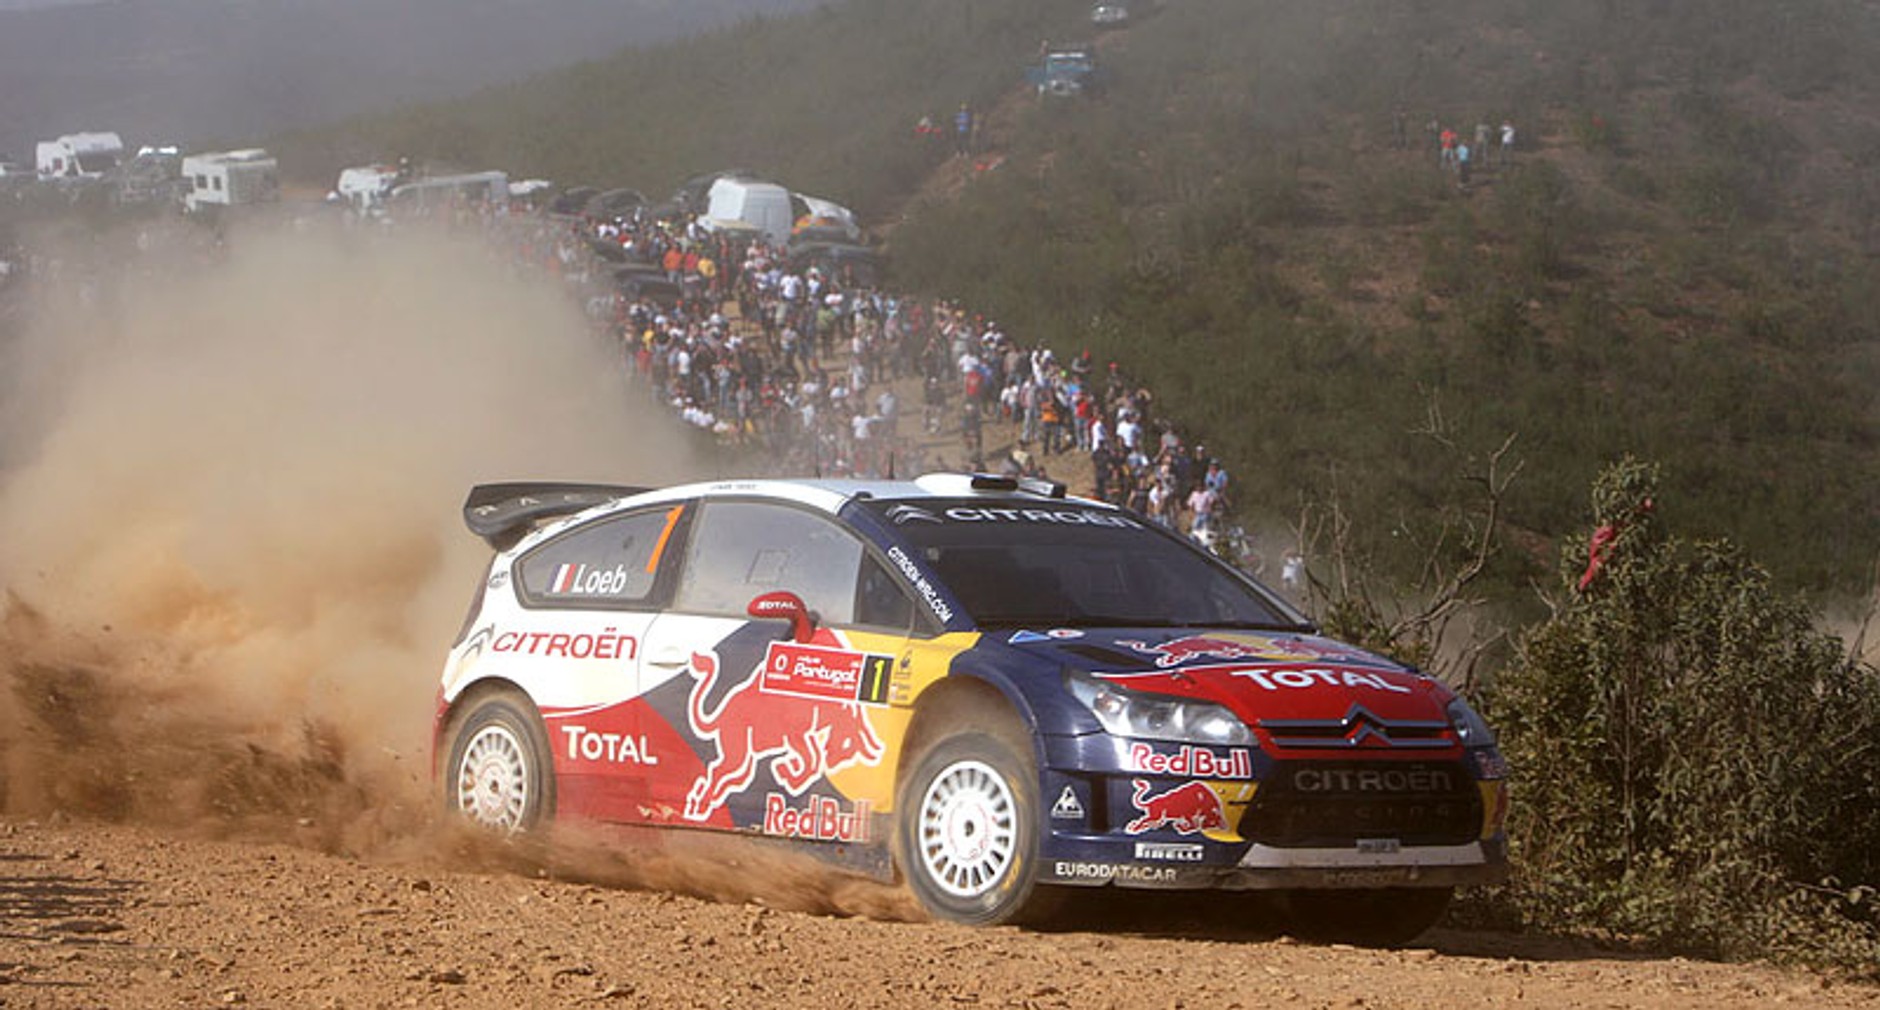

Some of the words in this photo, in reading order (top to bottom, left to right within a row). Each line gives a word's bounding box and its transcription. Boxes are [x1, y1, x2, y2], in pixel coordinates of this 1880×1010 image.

[645, 503, 685, 574] 1
[571, 563, 627, 594] Loeb
[871, 660, 885, 701] 1
[1231, 669, 1412, 694] TOTAL
[1131, 742, 1191, 776] Red
[1192, 745, 1253, 779] Bull
[764, 791, 818, 838] Red
[818, 796, 872, 843] Bull
[1054, 861, 1177, 882] EURODATACAR
